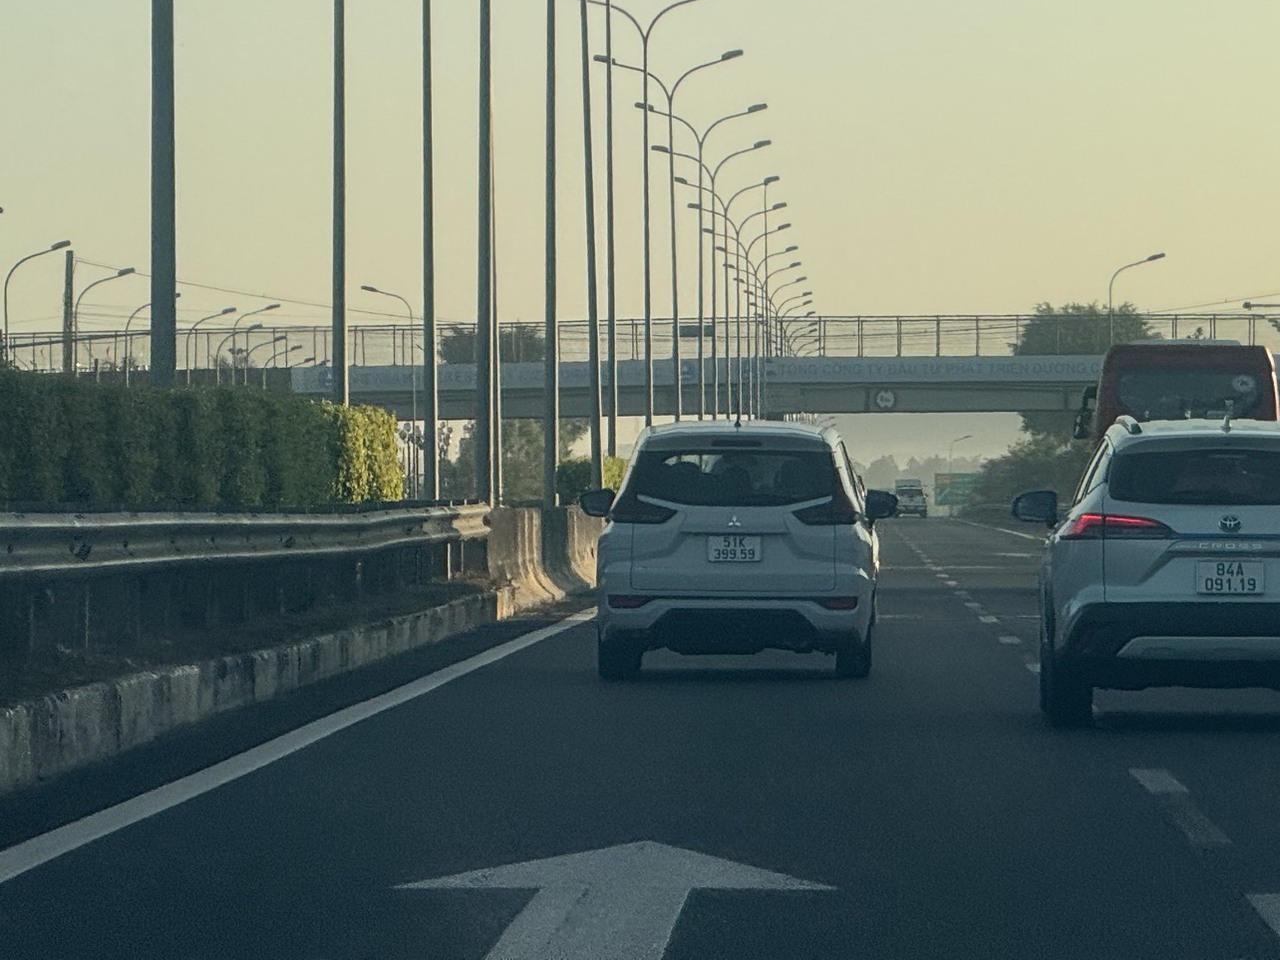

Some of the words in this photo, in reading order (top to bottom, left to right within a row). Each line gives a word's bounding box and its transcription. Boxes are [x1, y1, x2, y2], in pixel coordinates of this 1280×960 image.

[724, 537, 746, 548] 51K
[714, 548, 755, 559] 399.59
[1216, 562, 1244, 576] 84A
[1205, 578, 1256, 591] 091.19
